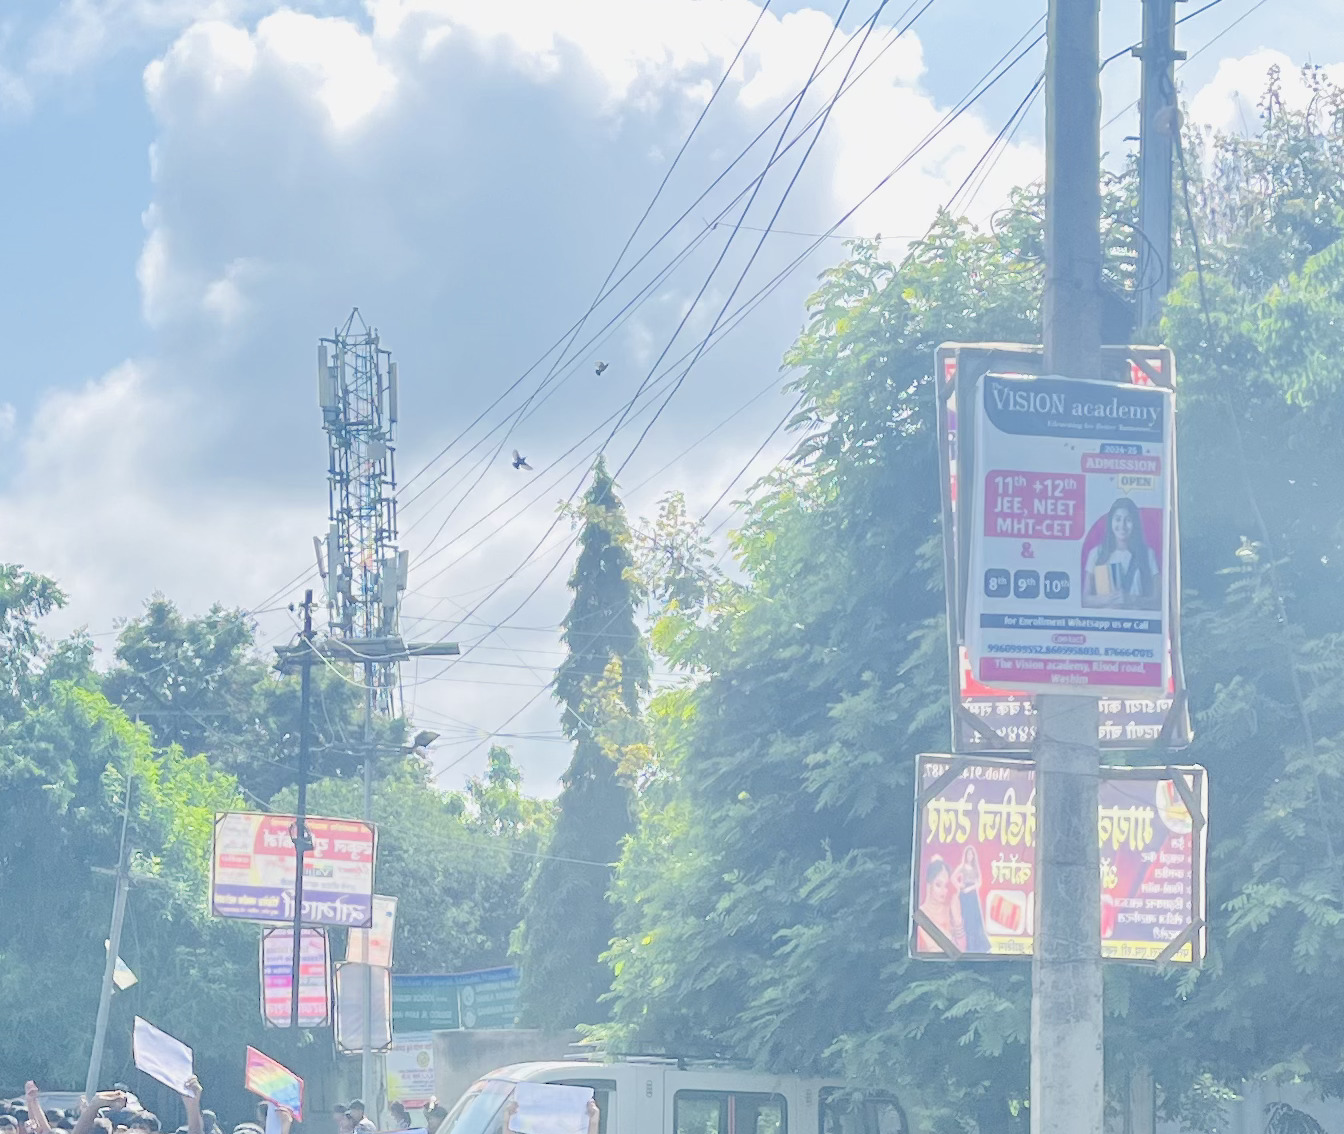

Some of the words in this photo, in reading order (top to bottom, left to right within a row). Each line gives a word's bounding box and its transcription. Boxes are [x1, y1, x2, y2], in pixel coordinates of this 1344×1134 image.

[993, 388, 1065, 415] VISION
[1071, 397, 1162, 427] academy
[1085, 456, 1157, 472] ADMISSION
[994, 475, 1027, 494] 11th
[1120, 475, 1152, 488] OPEN
[994, 496, 1028, 516] JEE,
[1033, 500, 1077, 516] NEET
[996, 519, 1073, 537] MHT-CET
[1020, 541, 1035, 559] &
[988, 576, 1007, 591] 8th
[1017, 577, 1037, 592] 9th
[1044, 578, 1070, 593] 10th
[1019, 616, 1066, 627] Enrollment
[1068, 617, 1110, 630] Whatsapp
[1133, 619, 1149, 630] Call
[994, 658, 1013, 669] The
